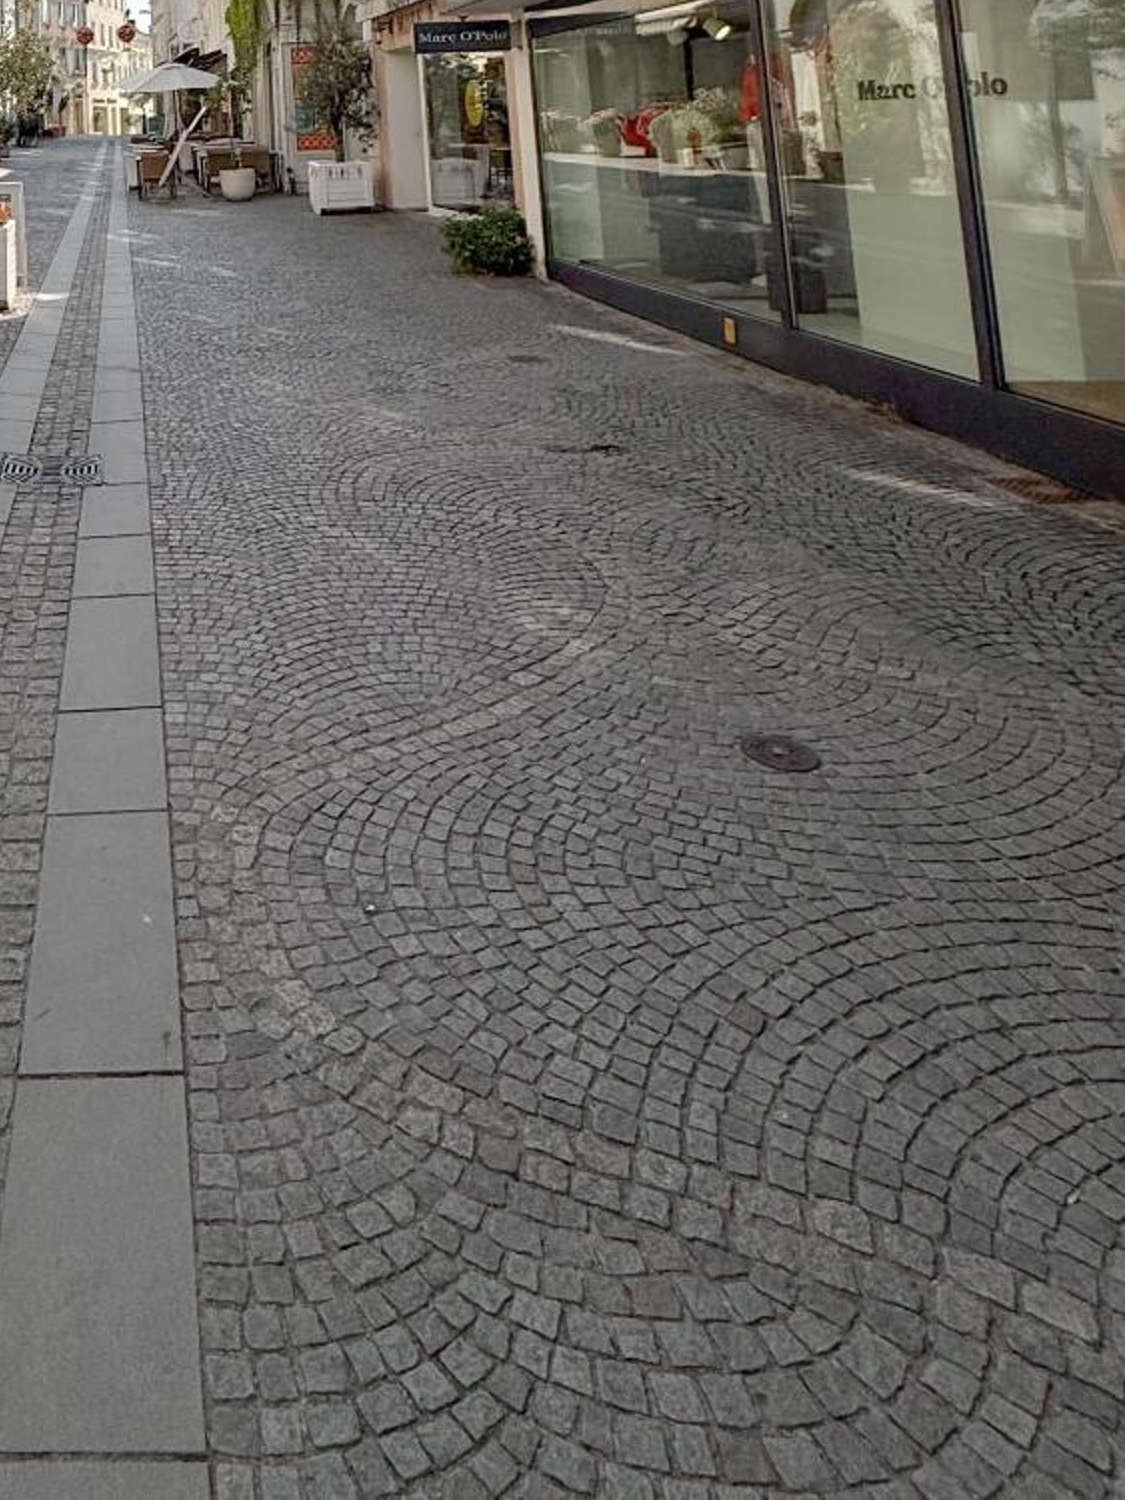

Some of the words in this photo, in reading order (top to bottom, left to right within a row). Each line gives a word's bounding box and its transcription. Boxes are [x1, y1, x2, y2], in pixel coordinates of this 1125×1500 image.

[418, 31, 456, 44] Marc
[460, 30, 508, 42] O'Polo
[857, 79, 916, 101] Marc
